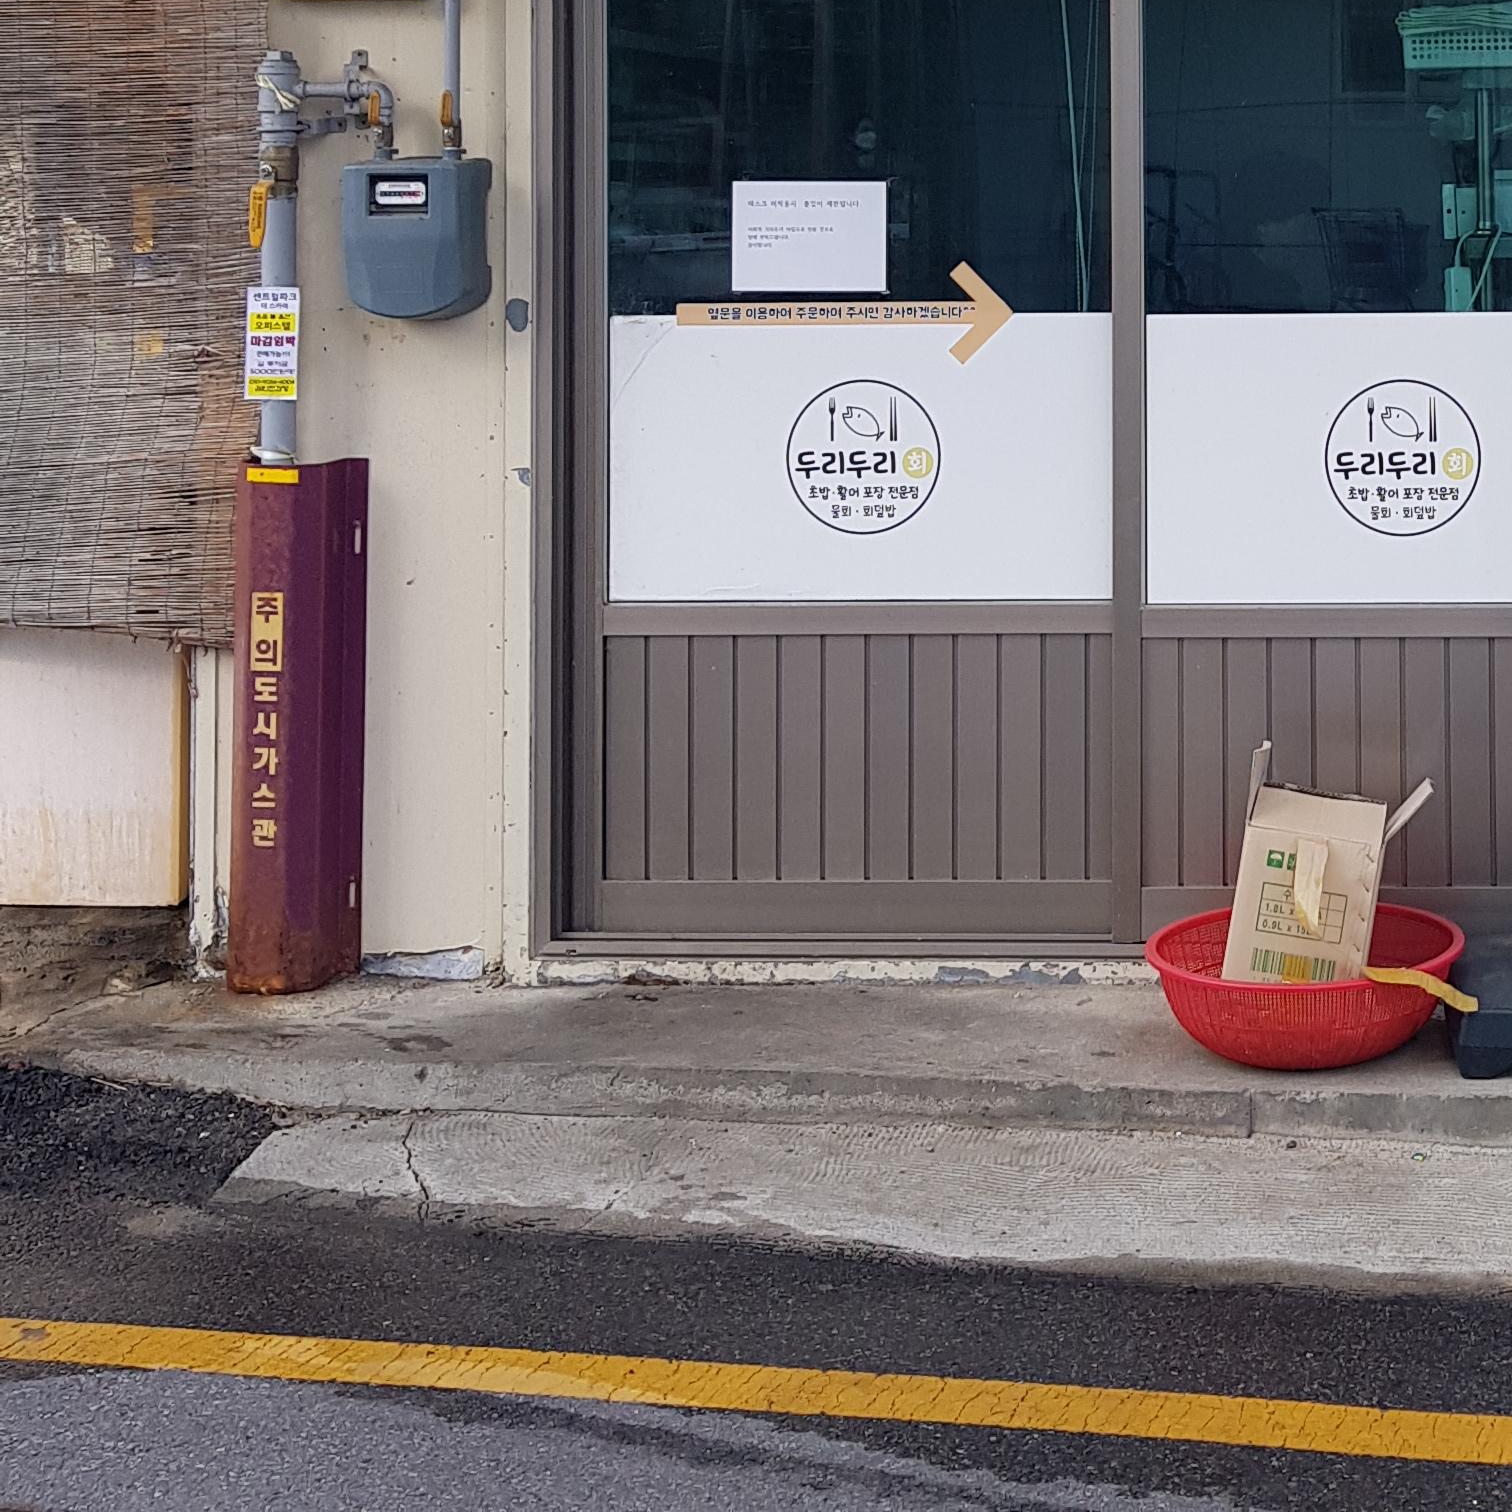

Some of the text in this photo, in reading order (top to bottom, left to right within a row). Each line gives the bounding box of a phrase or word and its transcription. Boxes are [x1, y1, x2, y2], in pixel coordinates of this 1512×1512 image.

[746, 307, 792, 320] 이용하여
[796, 307, 842, 320] 주문하여
[846, 306, 879, 319] 주시면
[250, 335, 295, 347] 마감임박
[795, 450, 927, 479] 두리두리 회
[1333, 451, 1467, 480] 두리두리 회
[863, 486, 885, 499] 포장
[888, 486, 919, 500] 전문점
[1402, 487, 1425, 501] 포장
[1428, 487, 1460, 501] 전문점
[831, 504, 852, 519] 물회
[1370, 506, 1391, 520] 물회
[254, 595, 279, 666] 주의
[250, 676, 280, 848] 도시가스관
